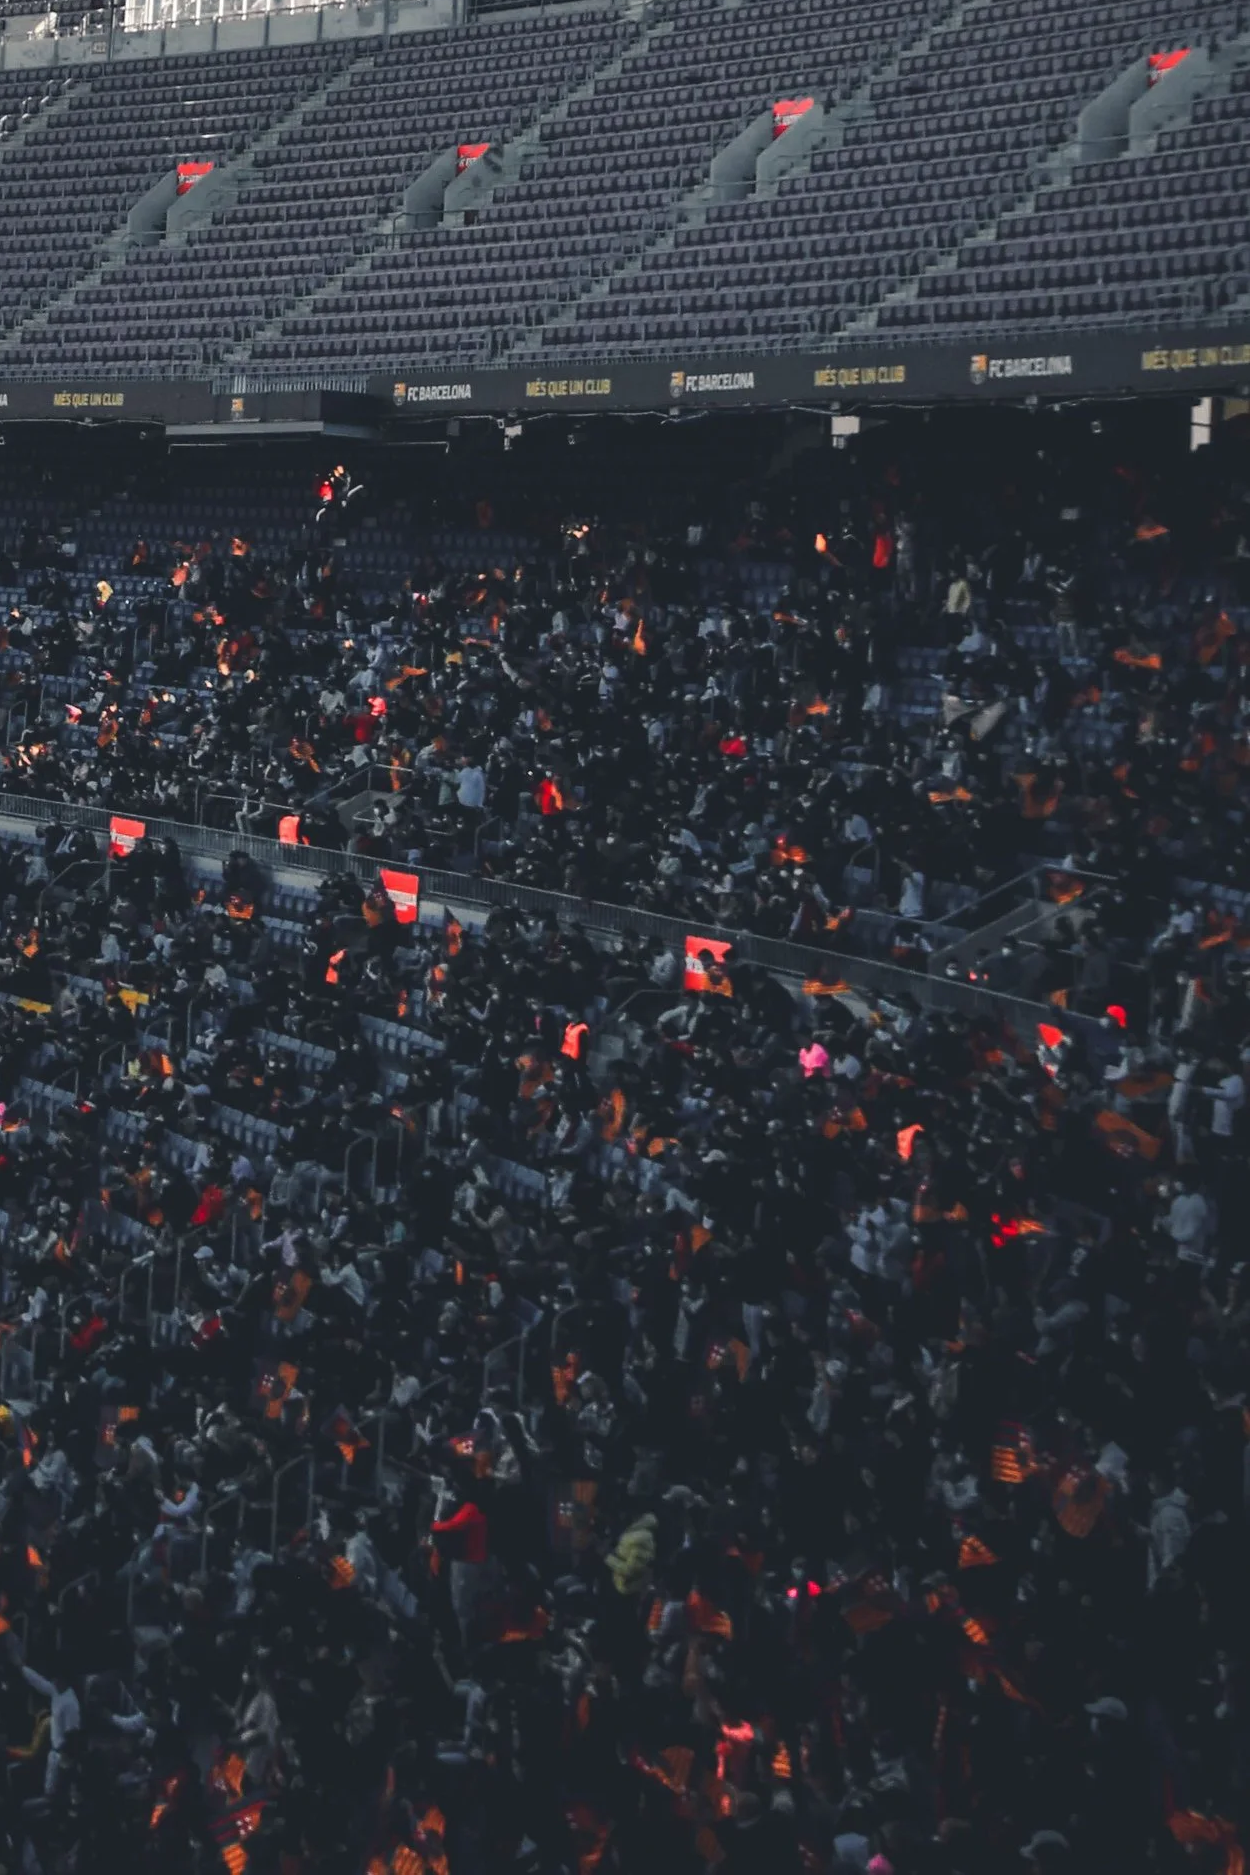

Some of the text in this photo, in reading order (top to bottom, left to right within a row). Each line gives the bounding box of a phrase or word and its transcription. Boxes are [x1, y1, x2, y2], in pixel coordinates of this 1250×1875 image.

[686, 372, 754, 391] FC BARCELONA
[838, 368, 859, 387] QUE
[861, 368, 876, 384] UN
[877, 365, 905, 383] CLUB
[408, 384, 471, 401] FC BARCELONA
[548, 380, 568, 398] QUE
[569, 380, 583, 395] UN
[585, 379, 610, 395] CLUB
[72, 393, 89, 408] QUE
[90, 393, 101, 406] UN
[102, 393, 124, 406] CLUB
